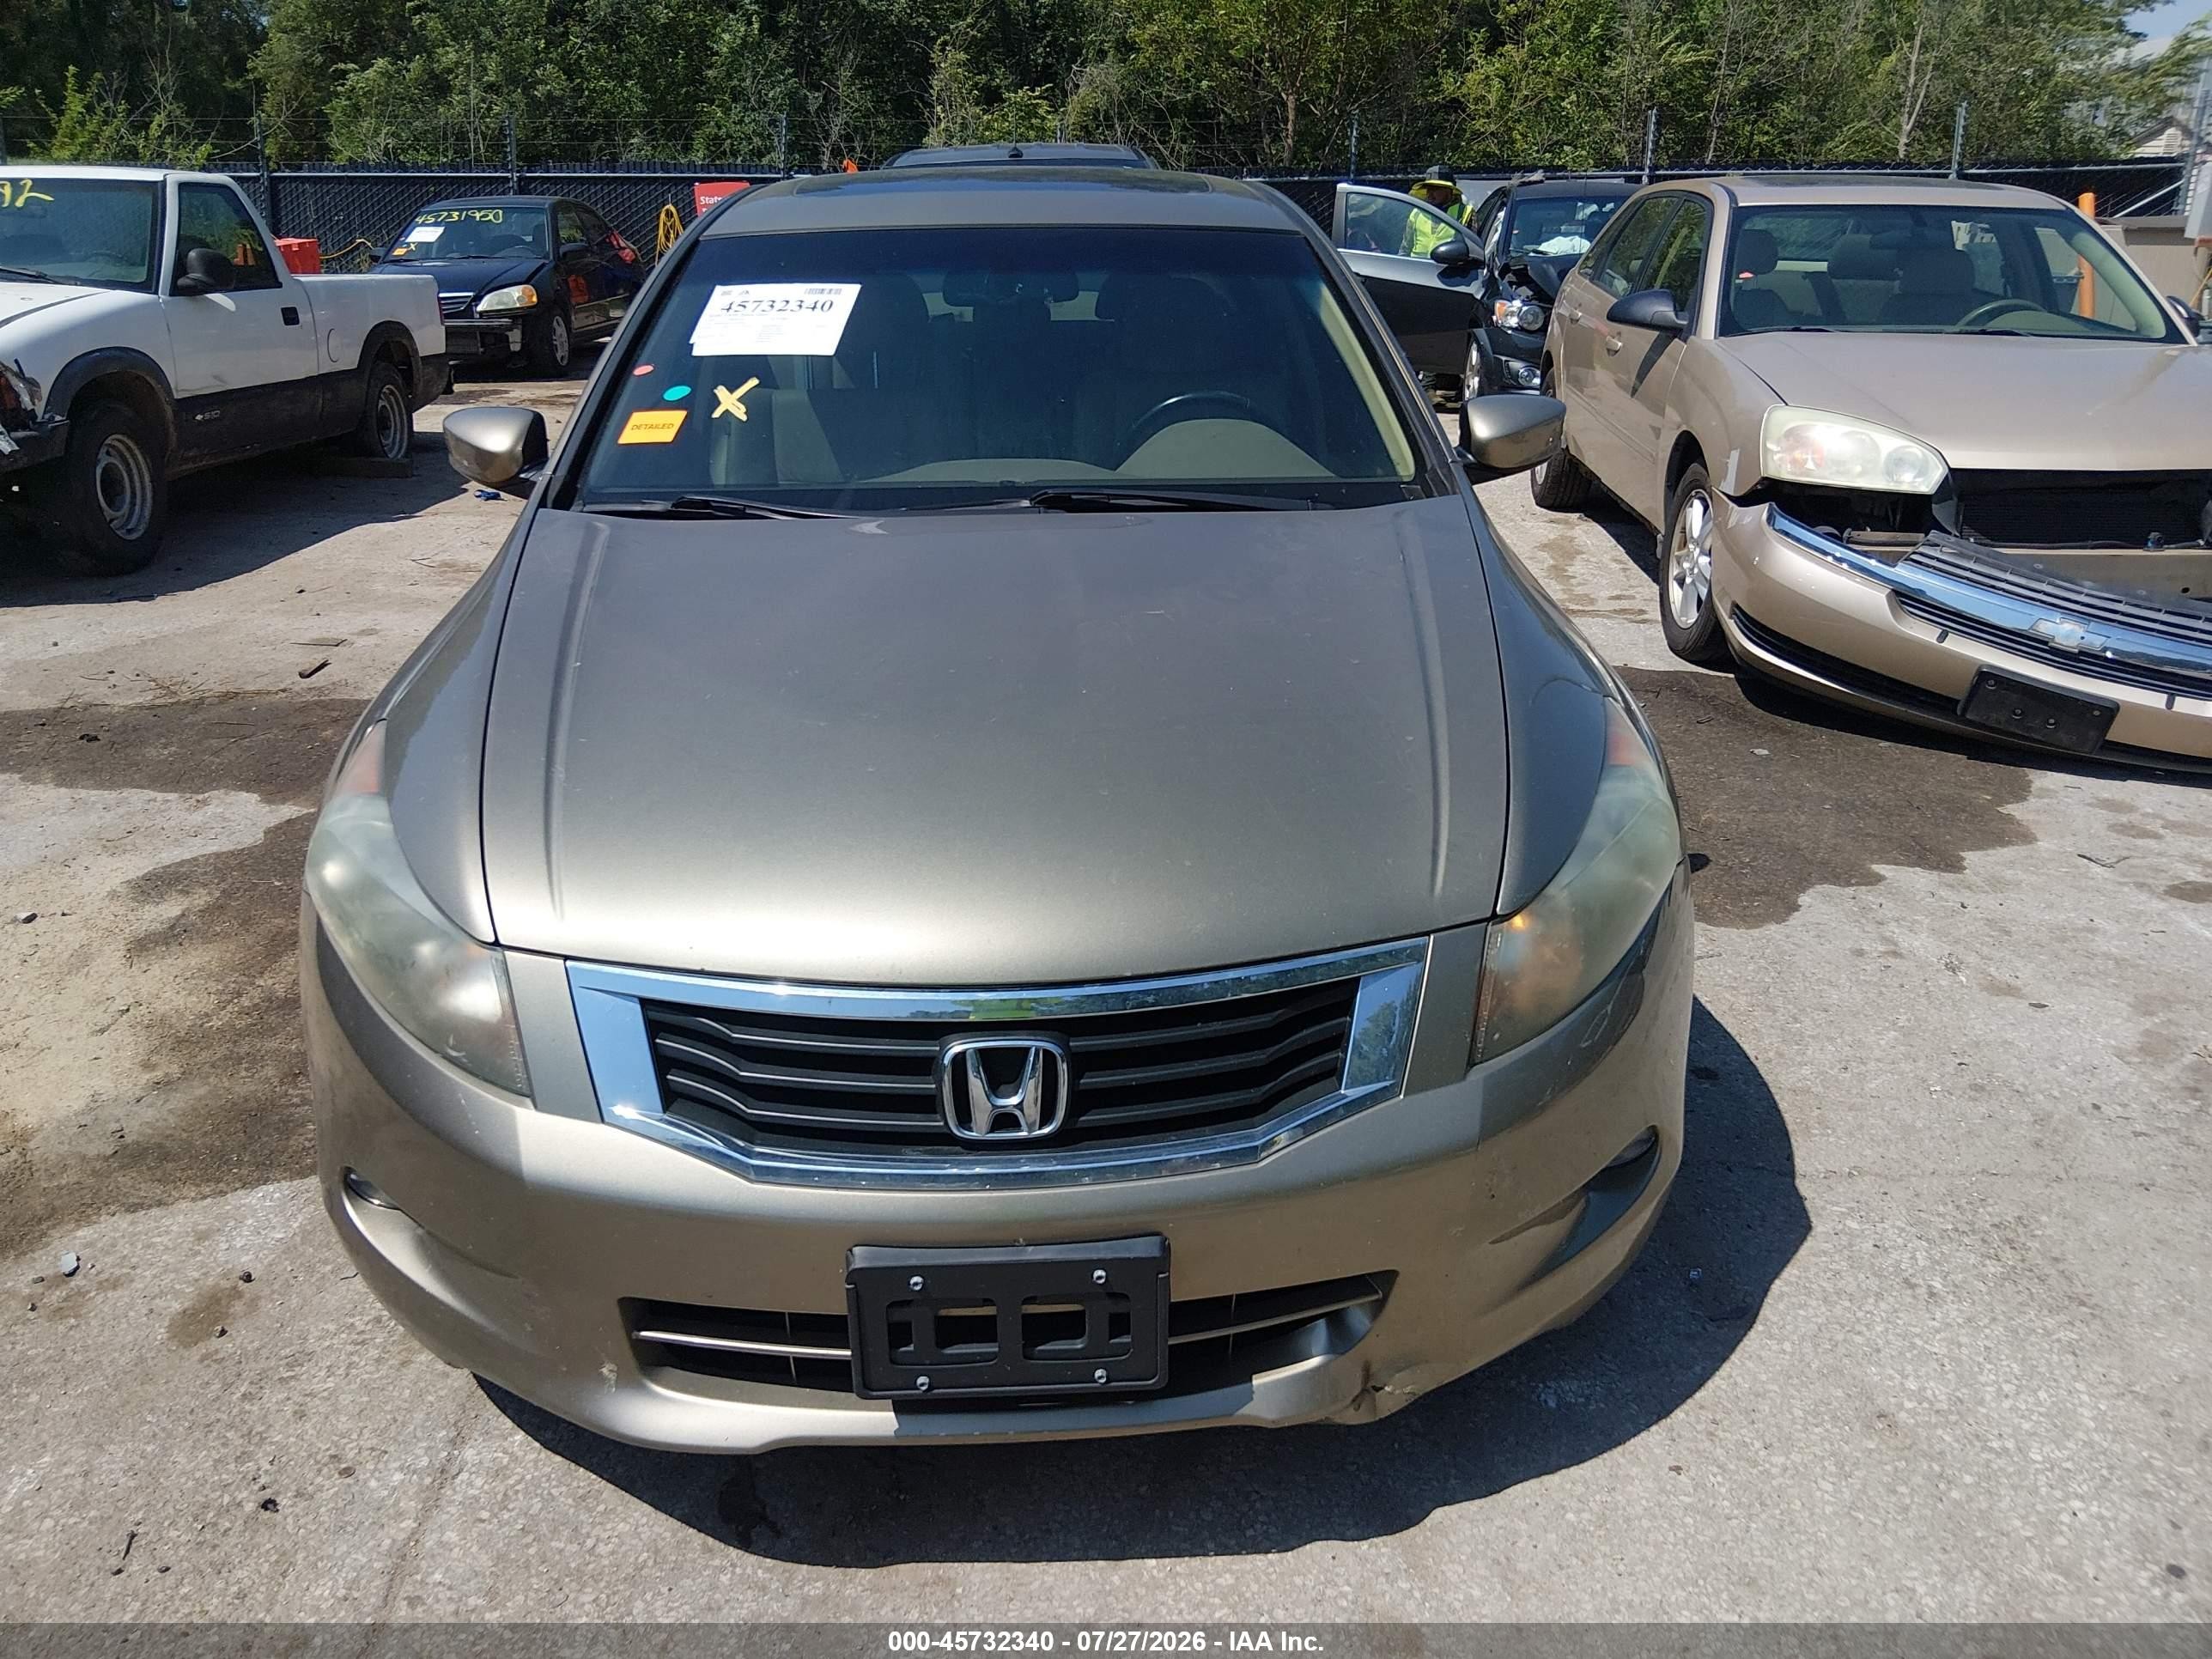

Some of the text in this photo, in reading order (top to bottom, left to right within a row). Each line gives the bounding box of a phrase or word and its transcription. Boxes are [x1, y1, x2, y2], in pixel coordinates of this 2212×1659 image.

[416, 209, 503, 224] 45731950
[720, 300, 835, 313] 45732340
[631, 422, 674, 431] DETAILED
